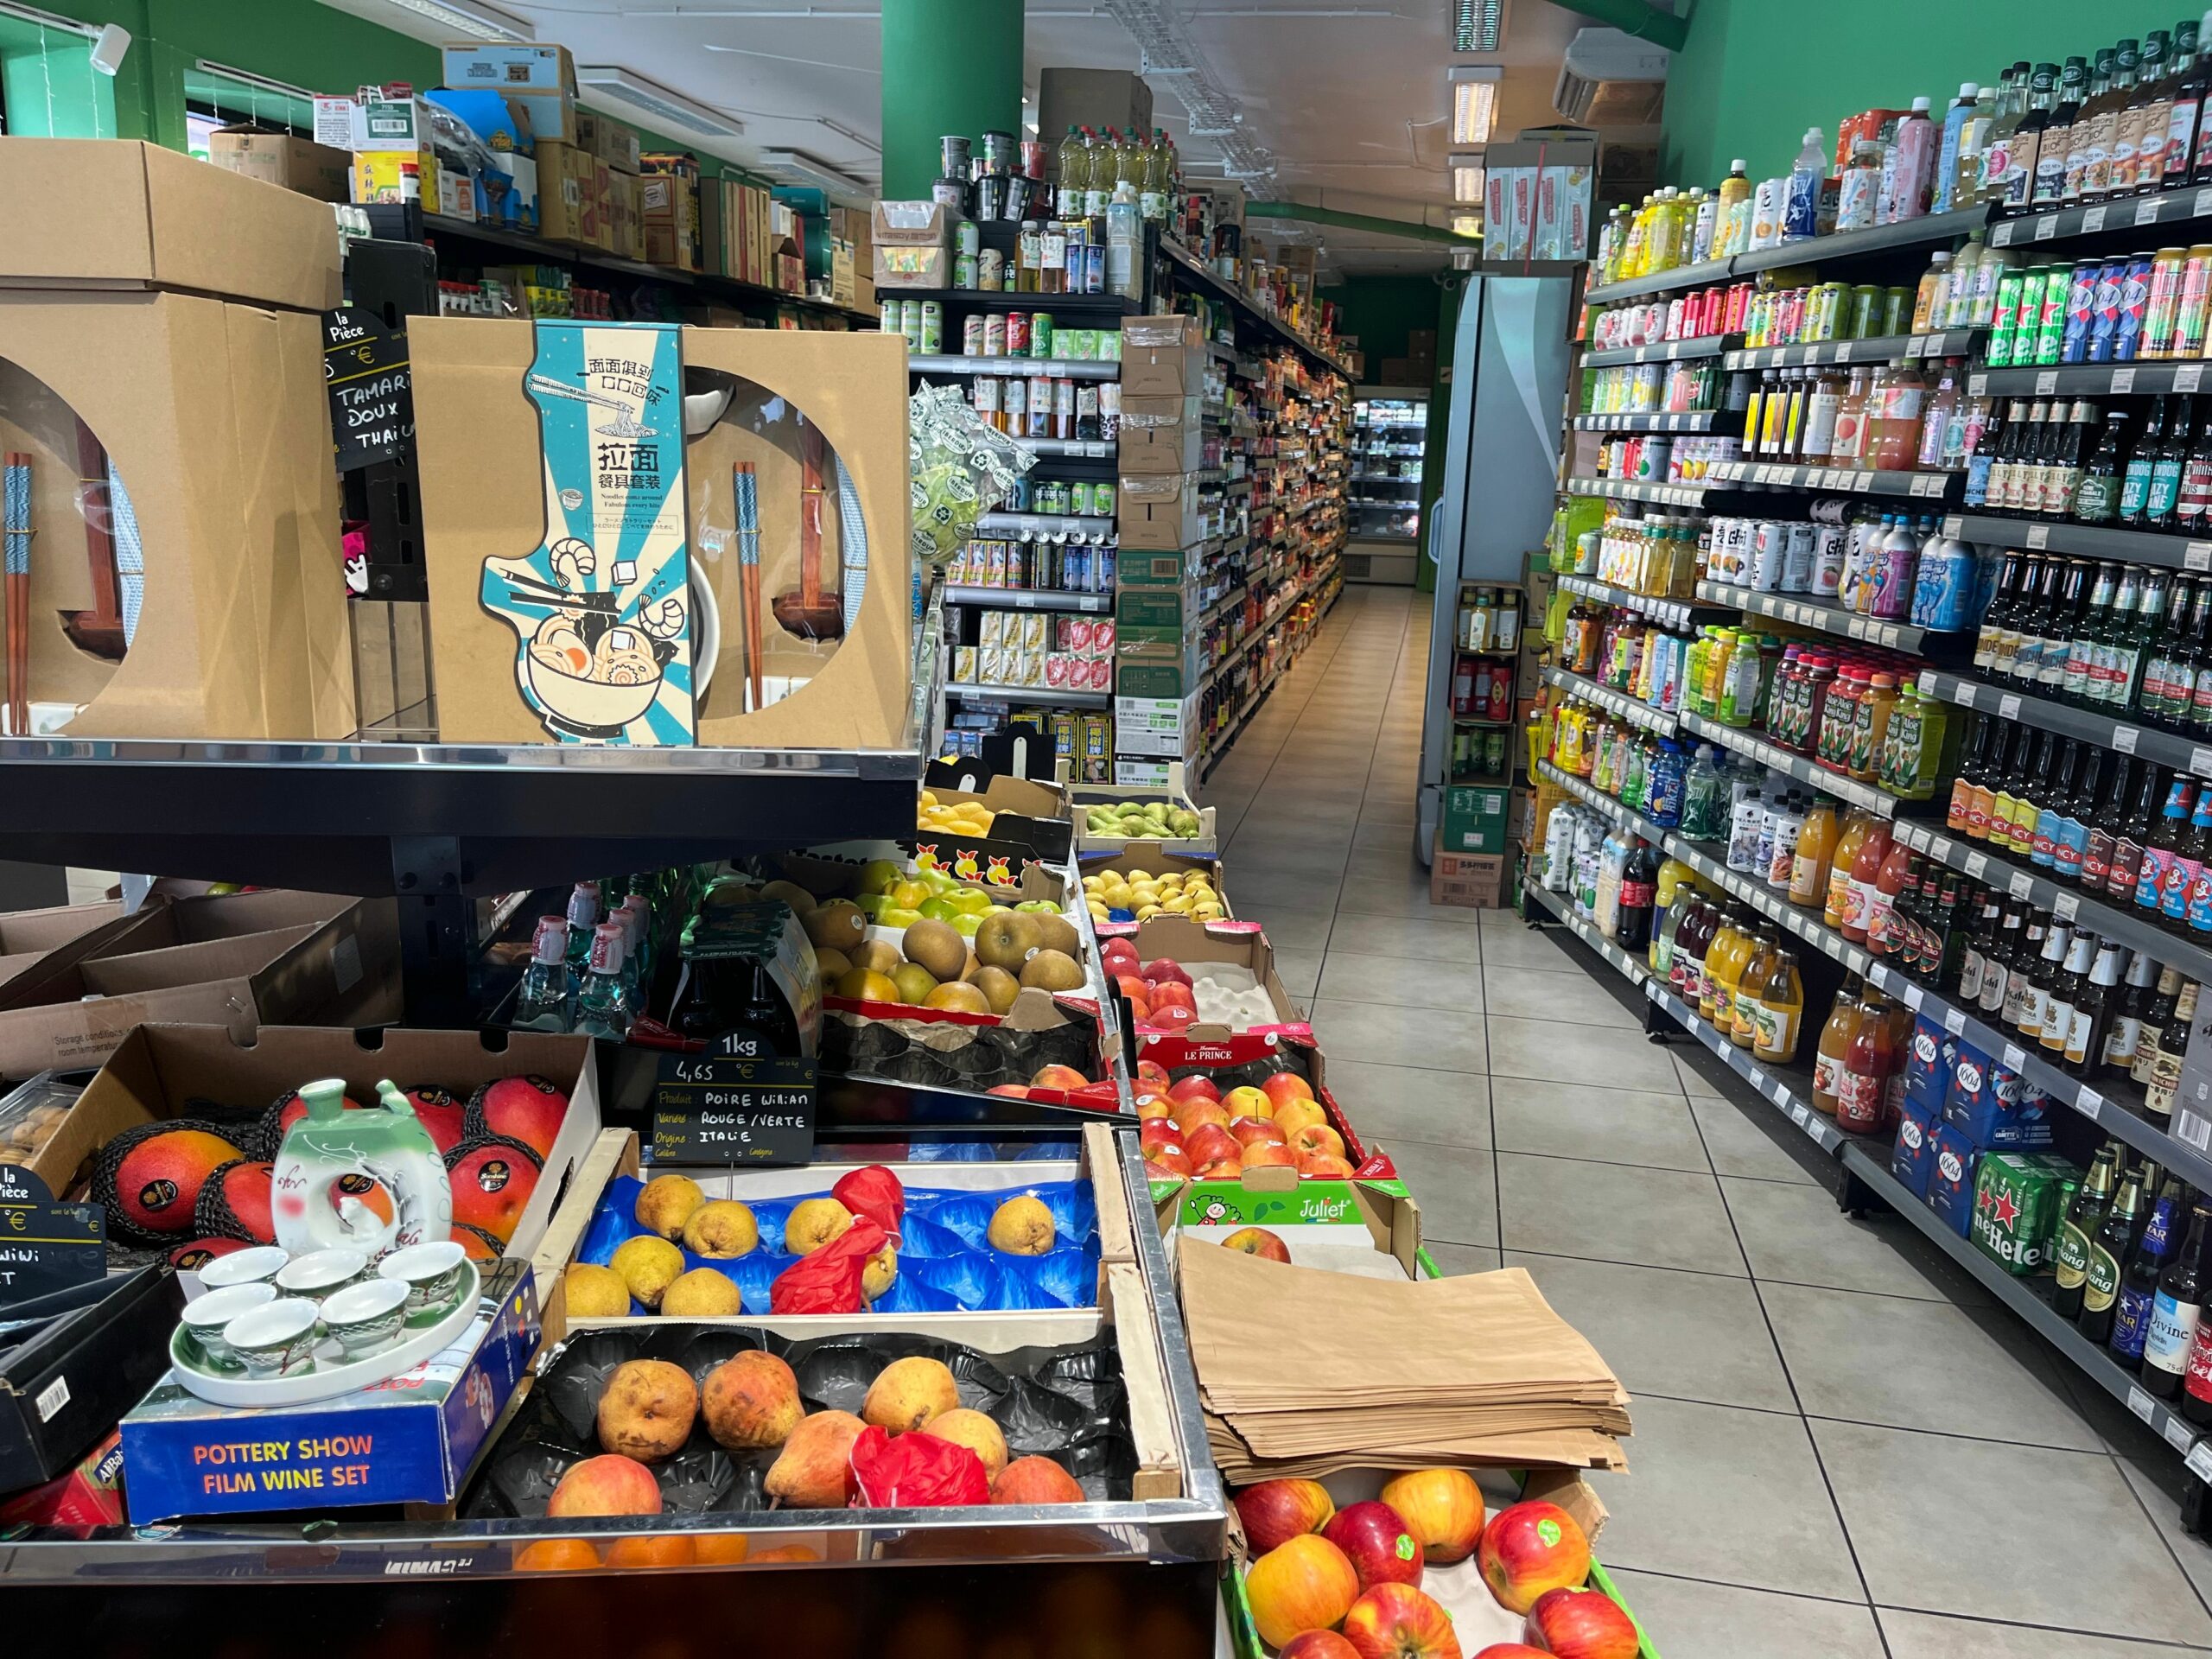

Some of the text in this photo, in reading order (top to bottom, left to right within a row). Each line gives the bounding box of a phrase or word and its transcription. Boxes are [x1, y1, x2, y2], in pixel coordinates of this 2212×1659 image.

[334, 311, 349, 326] la
[329, 327, 365, 342] Pièce
[588, 358, 655, 382] 面面俱到
[347, 402, 399, 427] DOUX
[597, 442, 659, 473] 拉面
[949, 478, 974, 499] IBERDUR
[1837, 696, 1853, 710] Aloe
[1857, 703, 1872, 715] Aloe
[1835, 708, 1852, 723] King
[1856, 714, 1870, 728] King
[1902, 718, 1920, 731] Aloe
[1901, 728, 1917, 743] King
[54, 1034, 84, 1046] Storage
[722, 1033, 758, 1057] 1kg
[1916, 1038, 1936, 1059] 1664
[58, 1042, 118, 1057] room temperatur
[1185, 1051, 1232, 1060] LE PRINCE
[676, 1061, 713, 1083] 4,65
[1958, 1066, 1980, 1090] 1664
[701, 1111, 747, 1125] ROUGE
[655, 1133, 686, 1147] Origine
[1902, 1124, 1922, 1145] 1664
[4, 1167, 16, 1183] la
[1940, 1156, 1961, 1179] 1664
[1300, 1198, 1347, 1218] Juliet
[2152, 1308, 2190, 1340] Divine
[194, 1434, 372, 1465] POTTERY SHOW
[203, 1464, 371, 1494] FILM WINE SET
